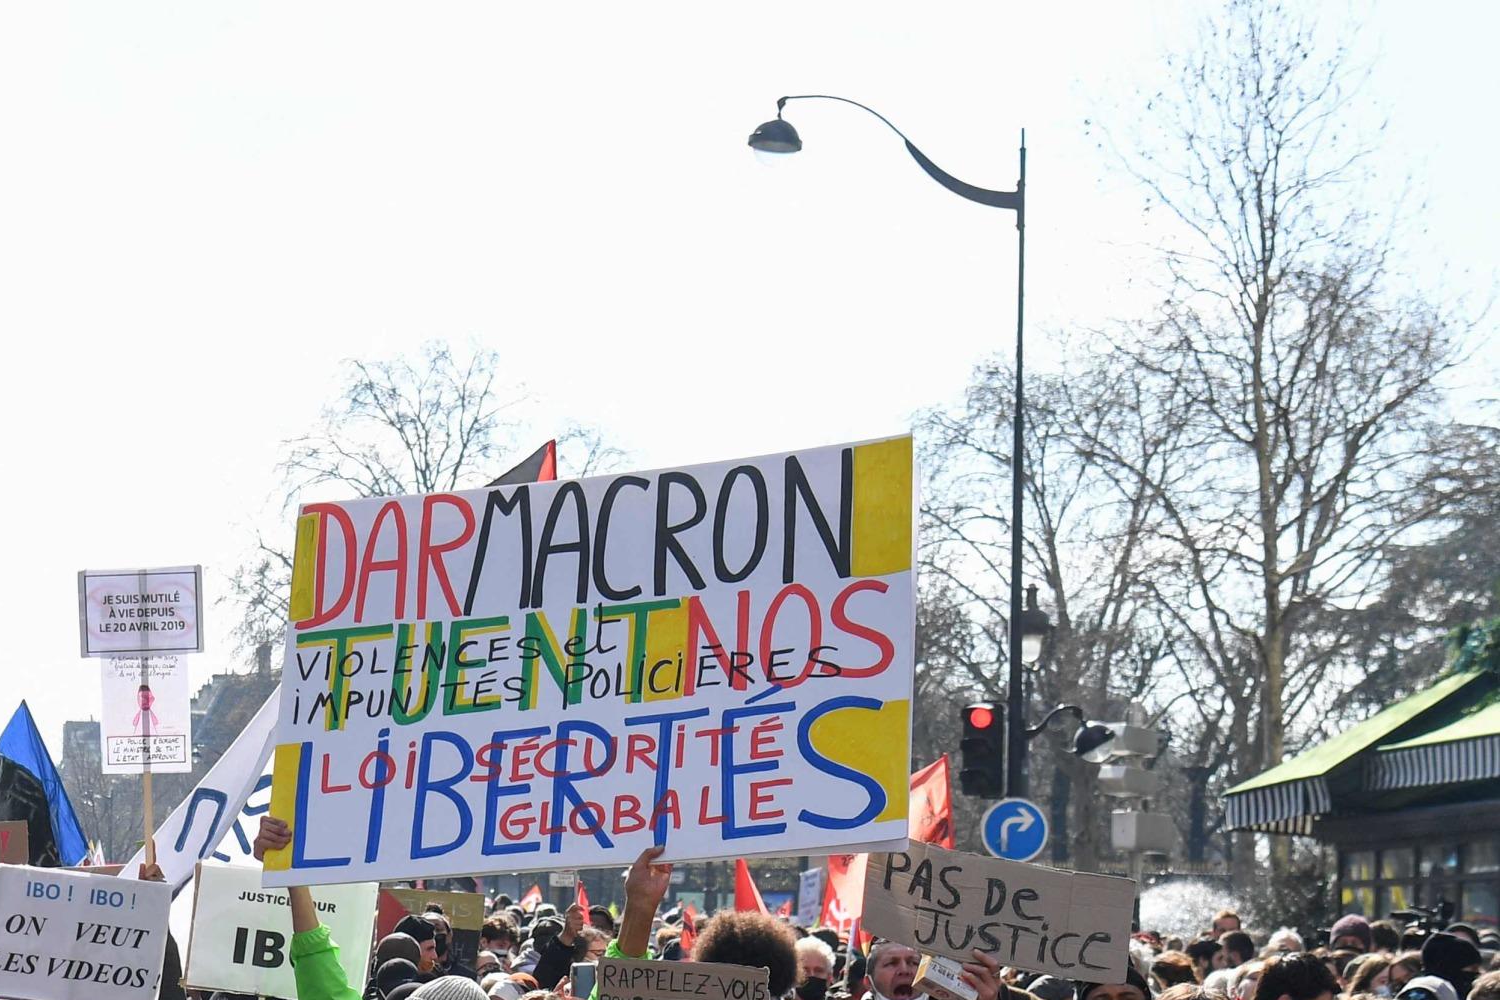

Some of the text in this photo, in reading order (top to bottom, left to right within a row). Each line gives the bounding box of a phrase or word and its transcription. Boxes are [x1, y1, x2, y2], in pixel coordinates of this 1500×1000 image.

[102, 590, 180, 606] JE SUIS MUTILÉ
[109, 607, 175, 619] À VIE DEPUIS
[100, 620, 185, 633] LE 20 AVRIL 2019
[564, 602, 618, 661] et
[683, 580, 895, 698] NOS
[499, 778, 793, 841] GLOBALE
[26, 881, 60, 900] IBO
[90, 889, 124, 908] IBO
[884, 852, 963, 909] PAS
[5, 913, 150, 950] ON VEUT
[233, 926, 287, 969] IB
[47, 957, 150, 989] VIDEOS
[603, 964, 765, 1000] RAPPELEZ-VOUS
